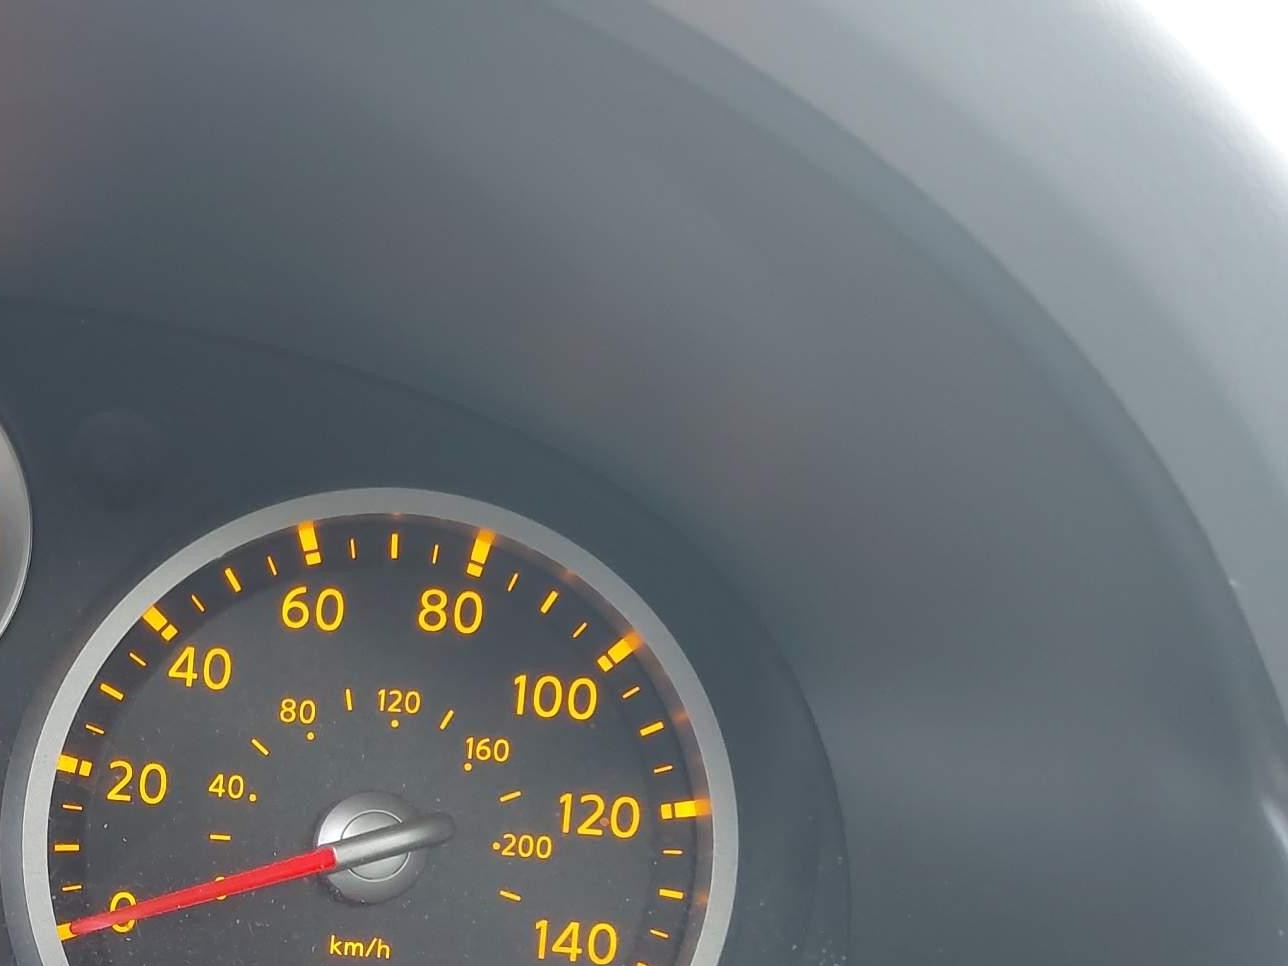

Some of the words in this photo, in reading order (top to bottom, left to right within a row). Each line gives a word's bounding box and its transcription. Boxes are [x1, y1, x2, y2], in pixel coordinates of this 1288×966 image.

[281, 585, 345, 632] 60
[417, 588, 483, 635] 80
[167, 646, 233, 691] 40
[279, 698, 316, 725] 80
[376, 688, 421, 715] 120
[513, 674, 598, 721] 100
[465, 737, 510, 762] 160
[106, 759, 168, 805] 20
[207, 773, 245, 800] 40
[558, 792, 641, 839] 120
[500, 834, 553, 859] 200
[108, 891, 138, 934] 0
[327, 934, 391, 959] km/h
[534, 918, 619, 966] 140
